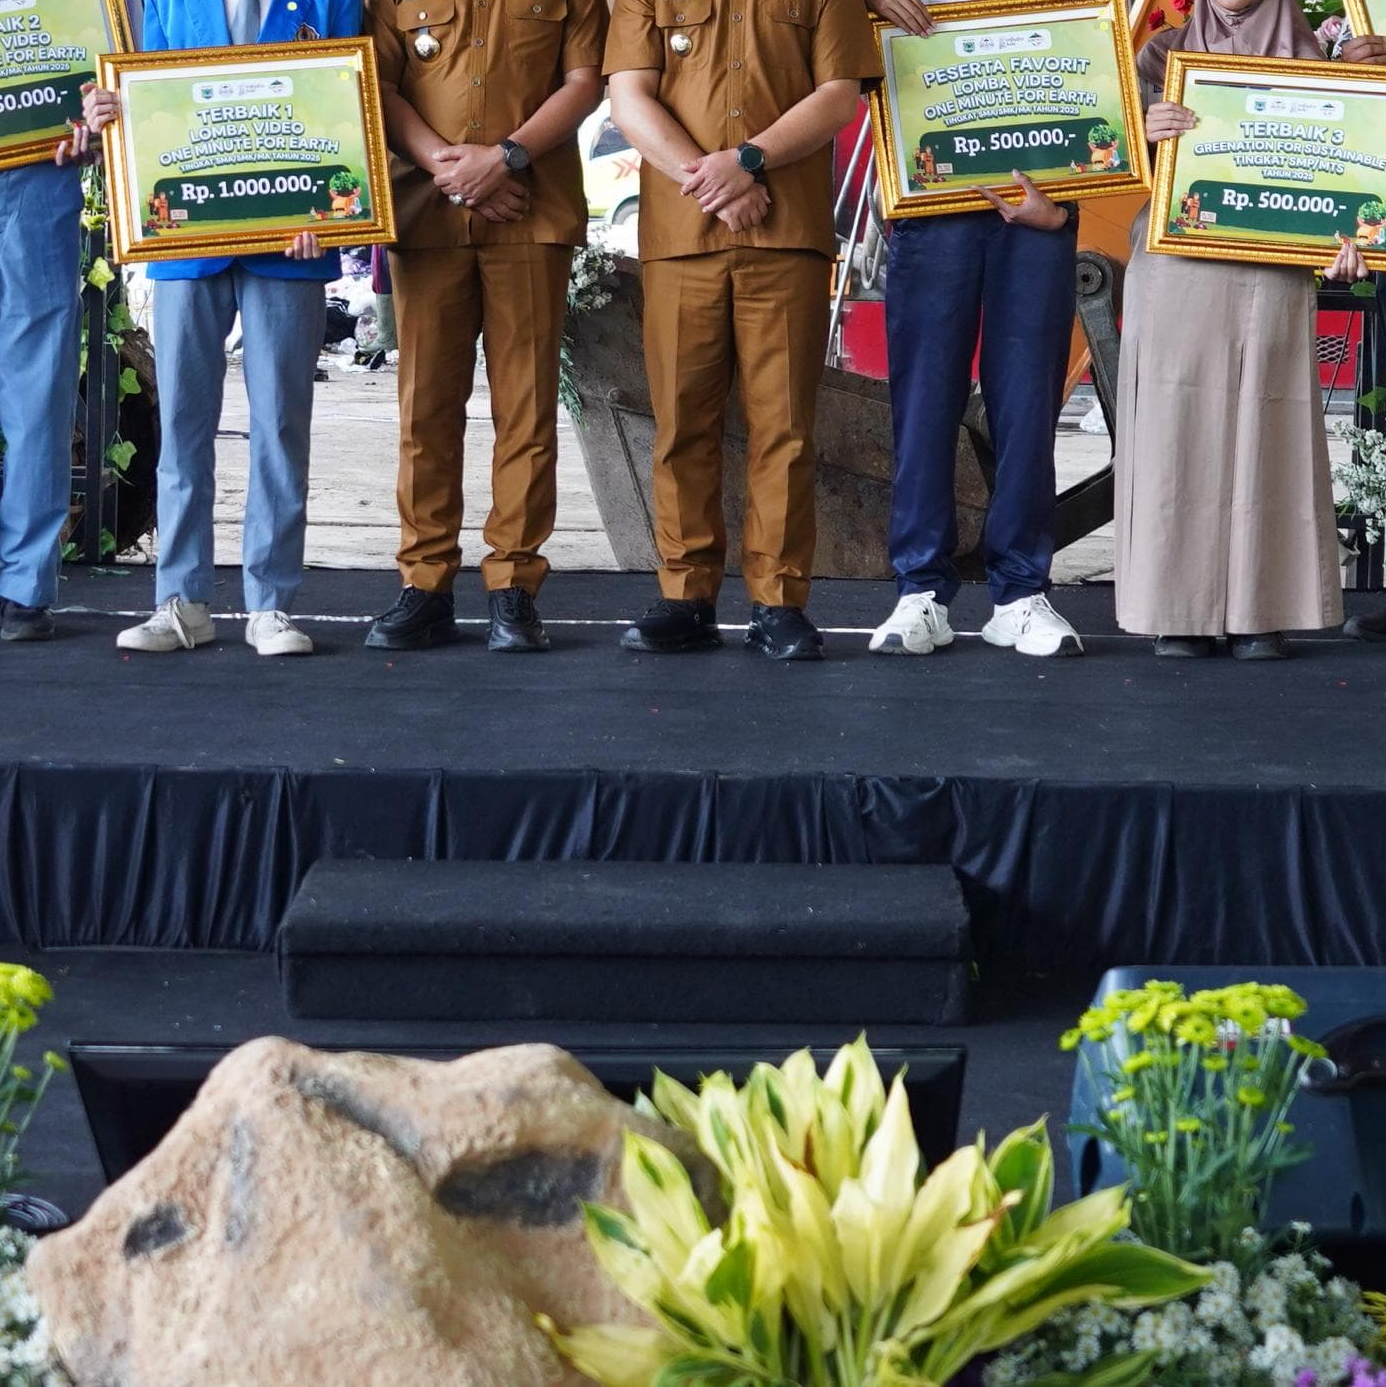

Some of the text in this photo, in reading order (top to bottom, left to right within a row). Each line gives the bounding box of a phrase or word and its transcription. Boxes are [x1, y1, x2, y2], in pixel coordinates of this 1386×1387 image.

[29, 14, 41, 30] 2
[1, 33, 51, 50] VIDEO
[5, 49, 35, 65] FOR
[39, 47, 86, 62] EARTH
[923, 57, 1091, 88] PESERTA FAVORIT
[952, 75, 1063, 97] LOMBA VIDEO
[197, 104, 293, 125] TERBAIK 1
[924, 90, 1097, 120] ONE MINUTE FOR EARTH
[189, 122, 304, 144] LOMBA VIDEO
[954, 128, 1076, 157] Rp. 500.000,-
[1240, 121, 1344, 145] TERBAIK 3
[159, 137, 339, 166] ONE MINUTE FOR EARTH
[1194, 140, 1274, 156] GREENATION
[1277, 142, 1302, 154] FOR
[180, 159, 216, 172] TINGKAT
[273, 153, 300, 162] TAHUN
[1234, 154, 1344, 175] TINGKAT SMP/MTS
[1262, 169, 1292, 180] TAHUN
[181, 175, 325, 204] Rp. 1.000.000,-
[1222, 189, 1347, 217] Rp. 500.000,-
